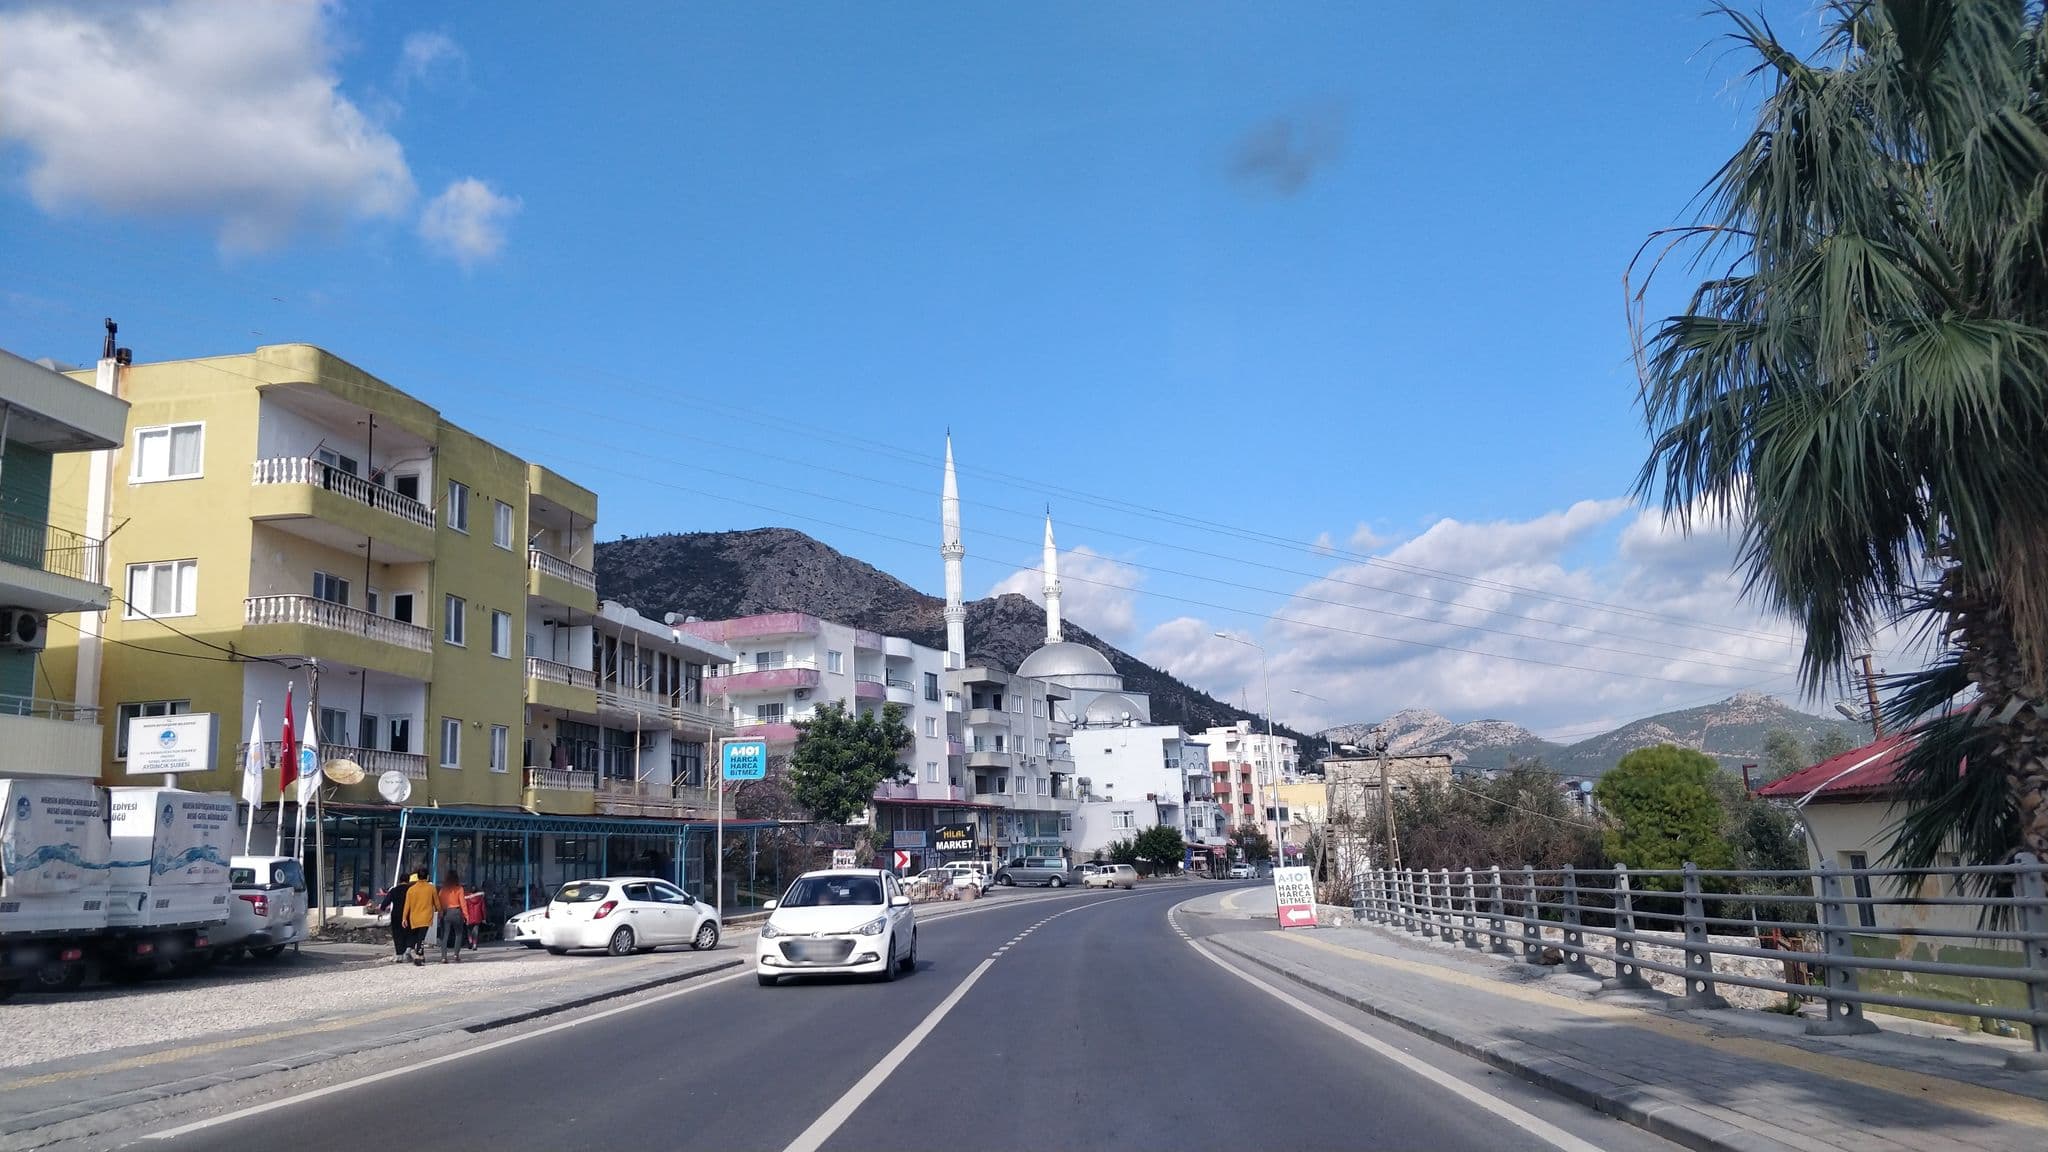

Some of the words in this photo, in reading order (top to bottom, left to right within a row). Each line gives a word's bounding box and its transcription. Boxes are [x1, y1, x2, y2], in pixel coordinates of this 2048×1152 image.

[943, 829, 966, 839] HİLAL
[936, 840, 973, 851] MARKET
[1278, 883, 1310, 891] HARCA
[1279, 890, 1311, 898] HARCA
